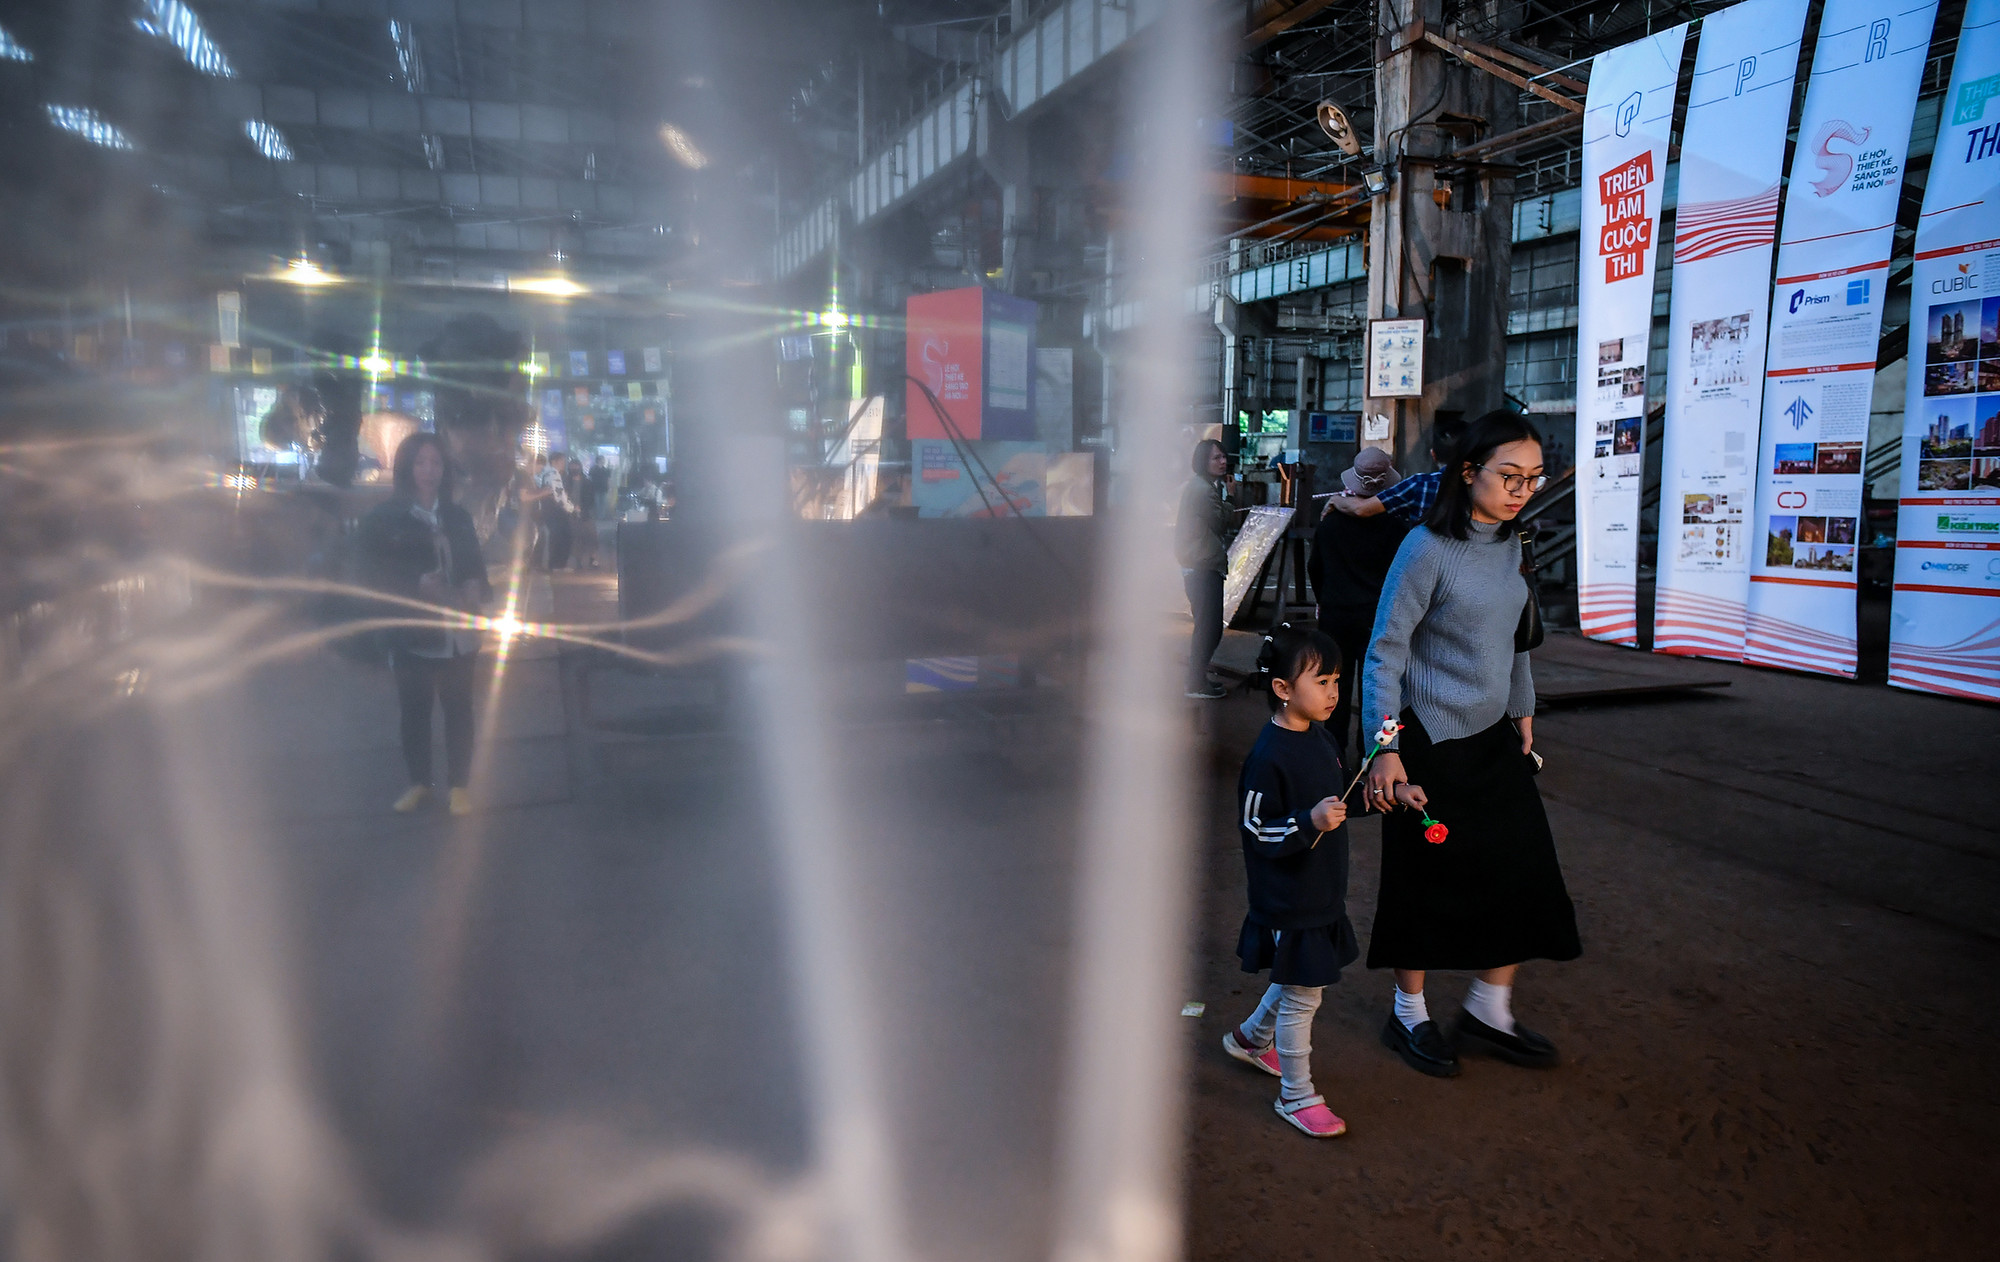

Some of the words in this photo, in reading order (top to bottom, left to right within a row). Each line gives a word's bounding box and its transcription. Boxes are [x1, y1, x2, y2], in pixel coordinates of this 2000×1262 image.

[1965, 73, 2000, 102] THIẾ
[1965, 120, 2000, 164] TH
[1604, 159, 1648, 197] TRIỂN
[1609, 194, 1642, 224] LÃM
[1603, 221, 1648, 252] CUỘC
[1612, 252, 1636, 277] THI
[1931, 273, 1979, 295] CUBIC
[1804, 294, 1830, 306] Prism
